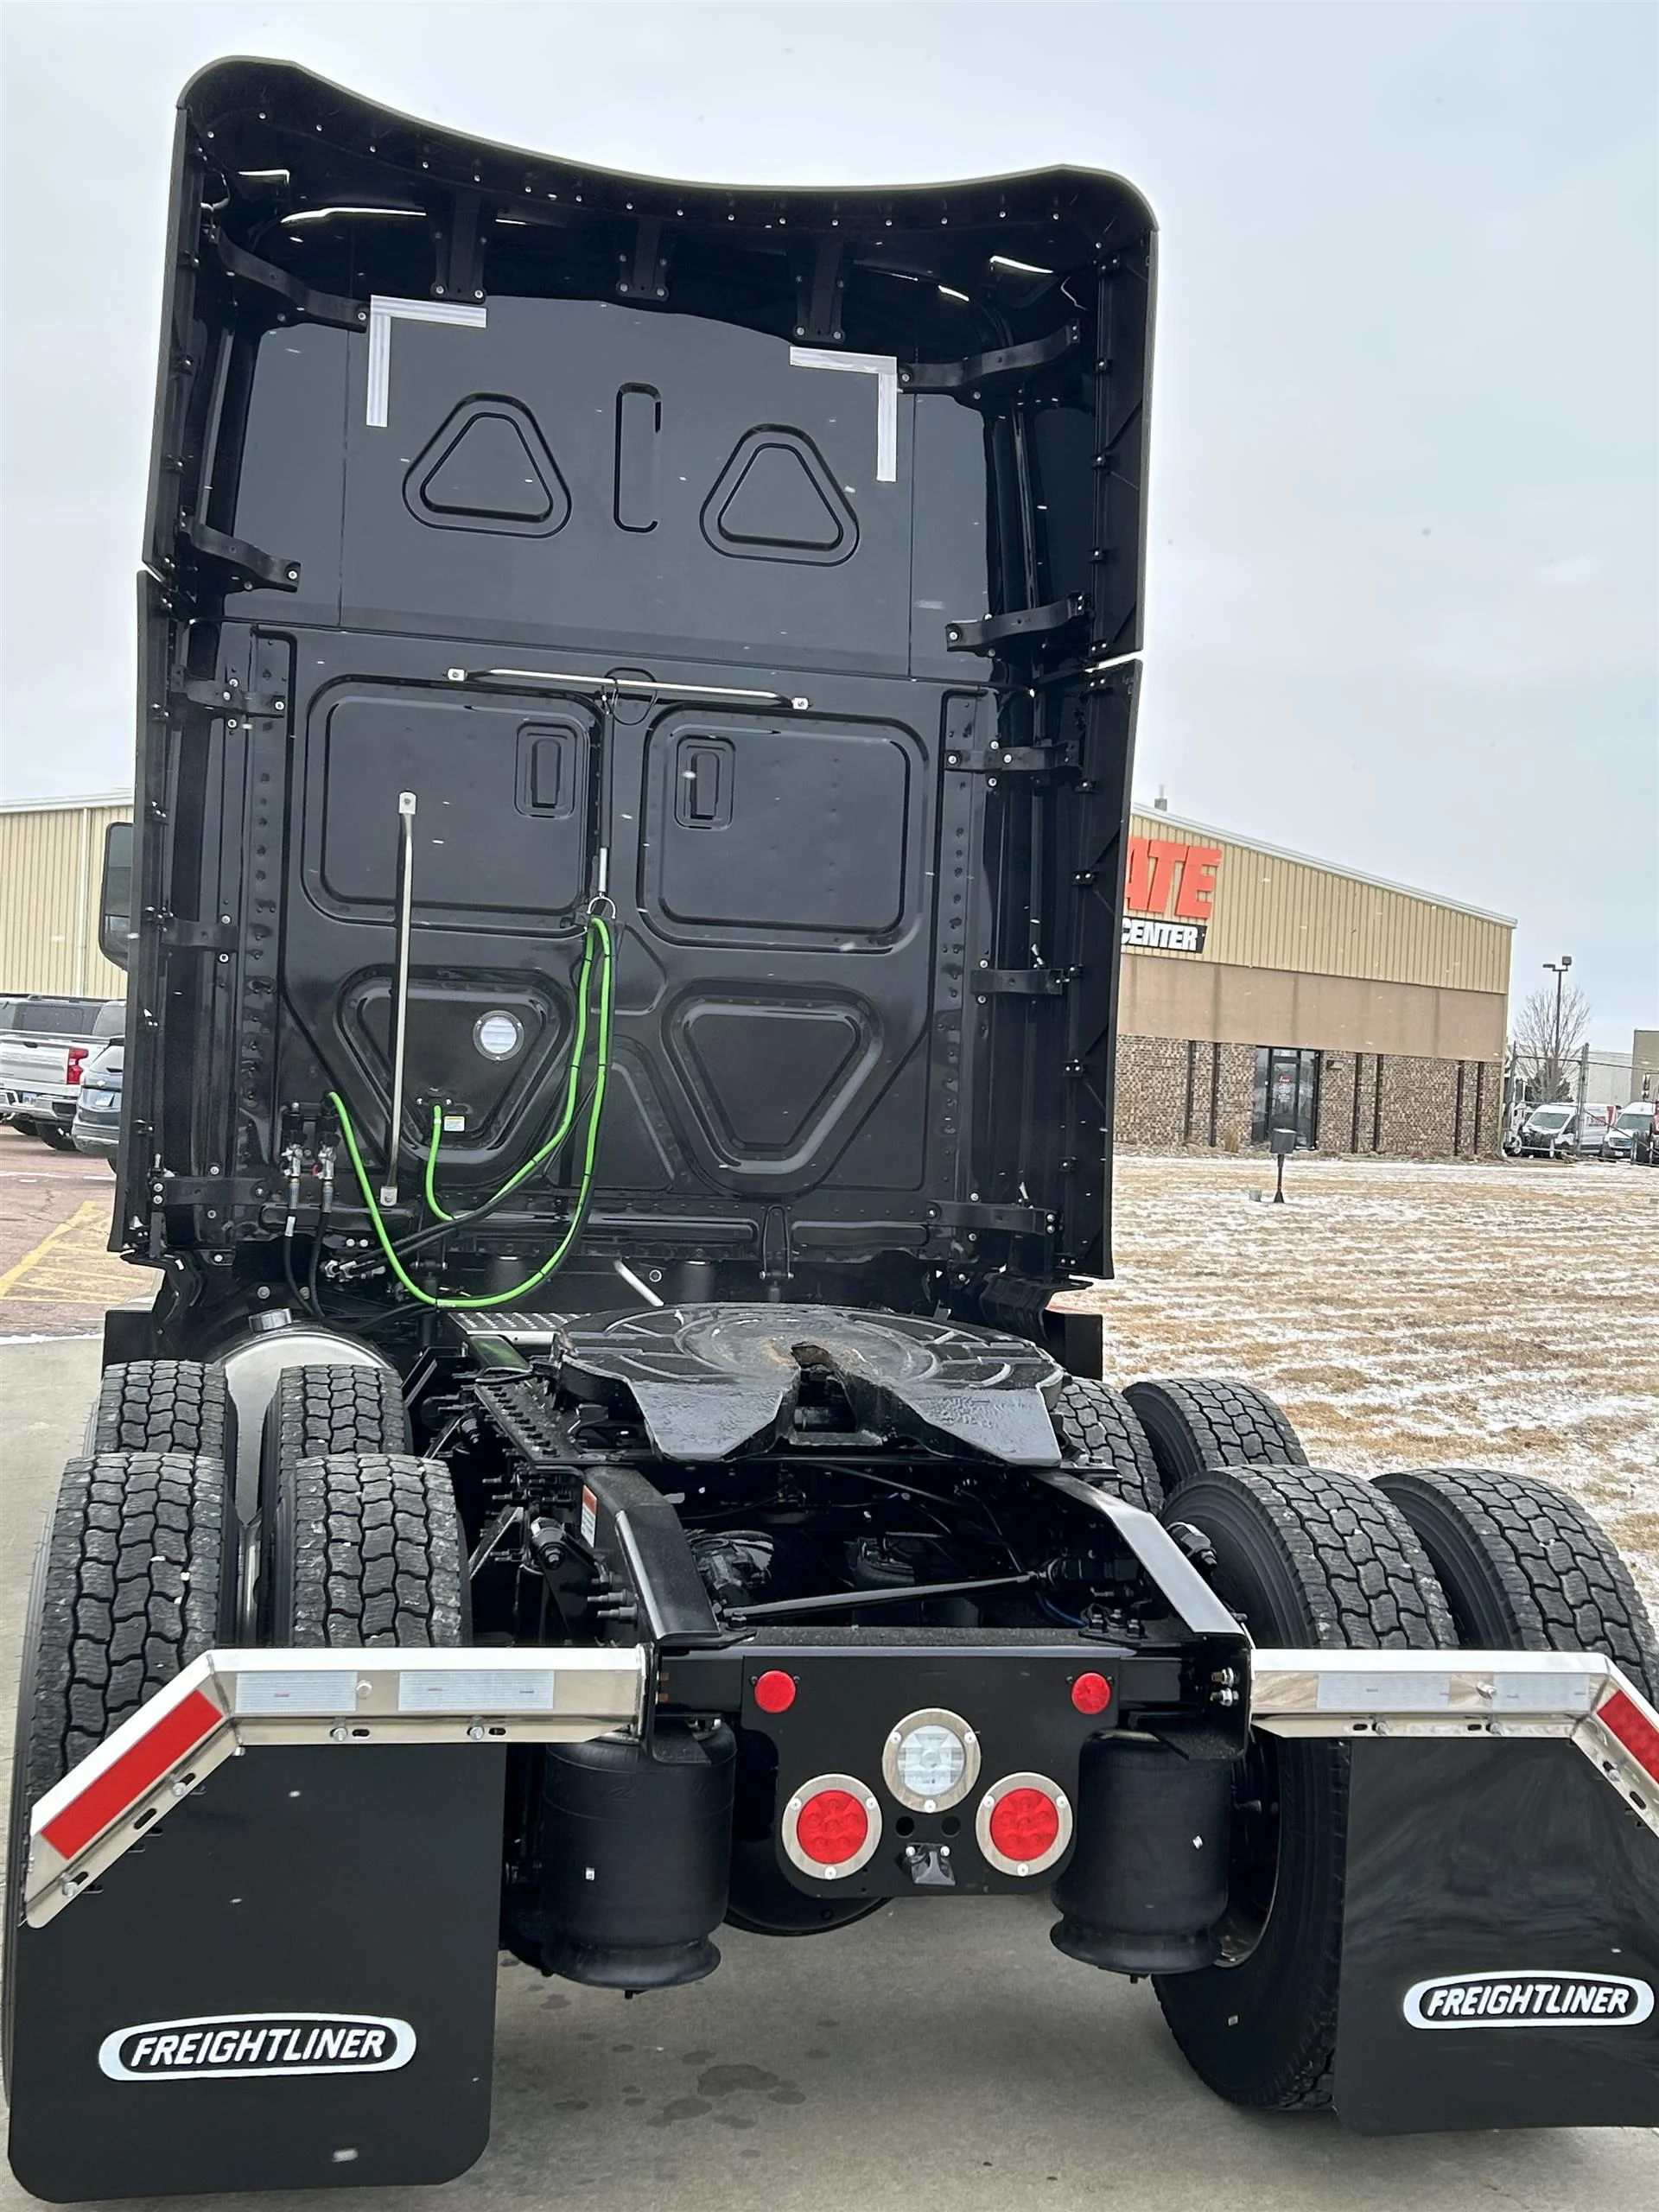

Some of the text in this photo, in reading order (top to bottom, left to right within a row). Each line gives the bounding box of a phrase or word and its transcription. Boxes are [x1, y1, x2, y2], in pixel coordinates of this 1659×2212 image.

[1122, 917, 1198, 950] CENTER
[1427, 1984, 1630, 2017] FREIGHTLINER
[130, 2028, 386, 2067] FREIGHTLINER
